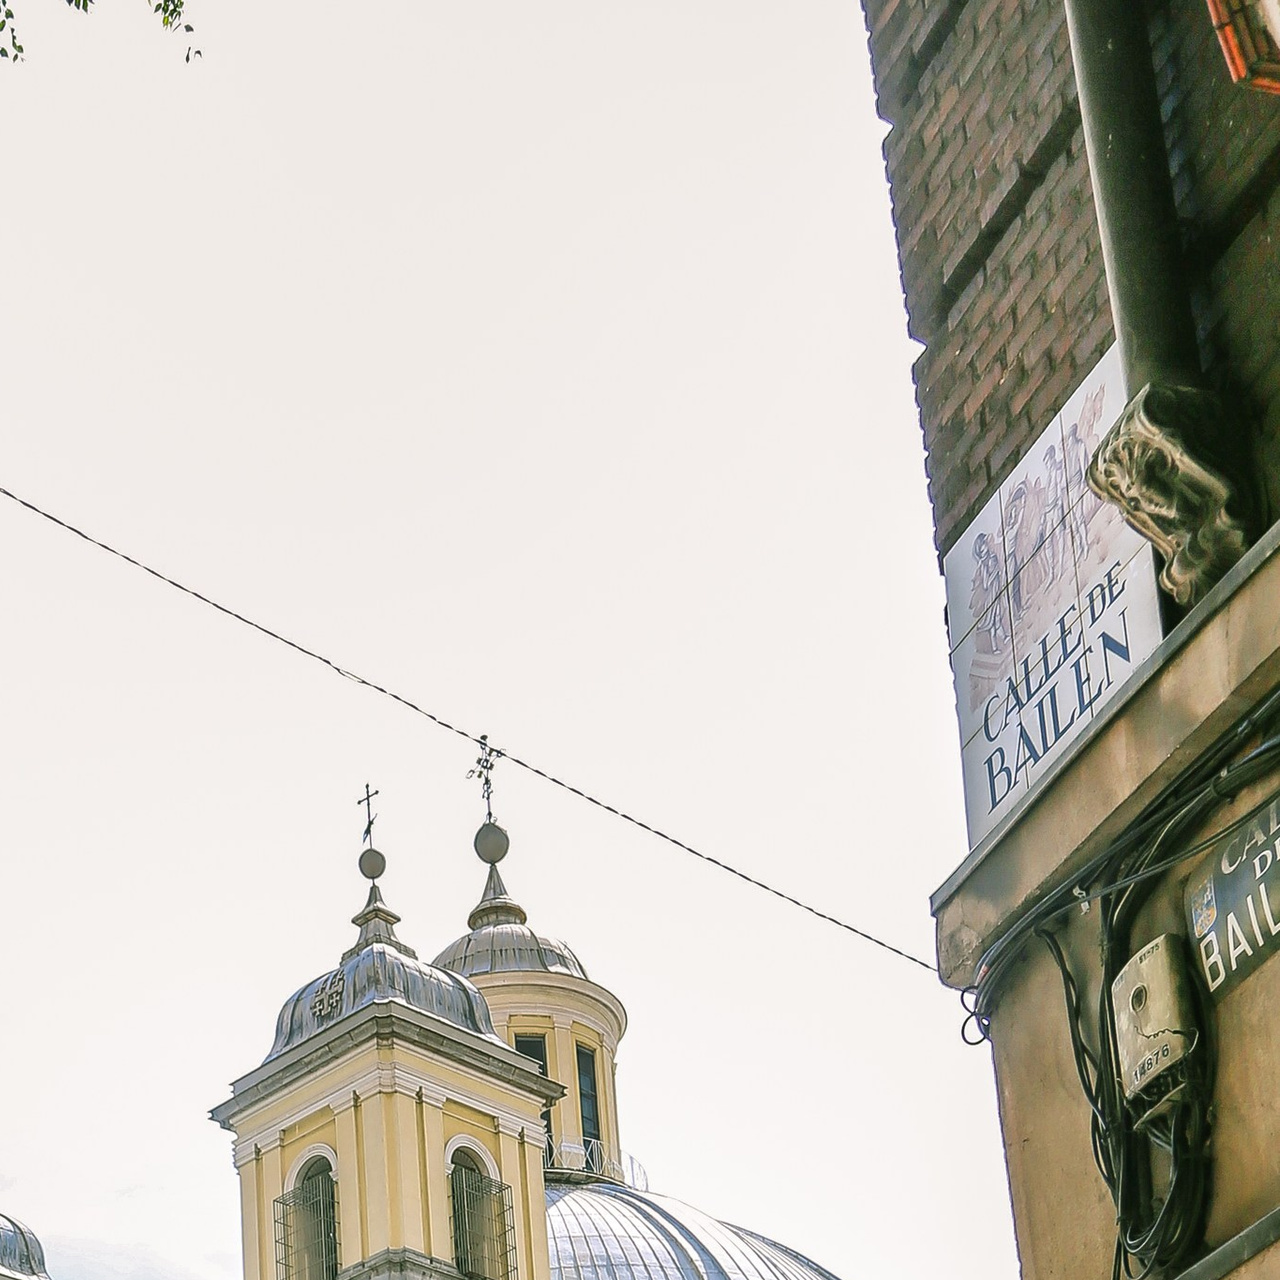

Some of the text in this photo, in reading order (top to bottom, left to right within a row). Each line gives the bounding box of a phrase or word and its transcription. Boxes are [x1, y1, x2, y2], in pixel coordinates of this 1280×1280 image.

[983, 606, 1132, 816] BAILEN
[984, 560, 1128, 743] CALLE DE
[1132, 1043, 1170, 1083] 14876
